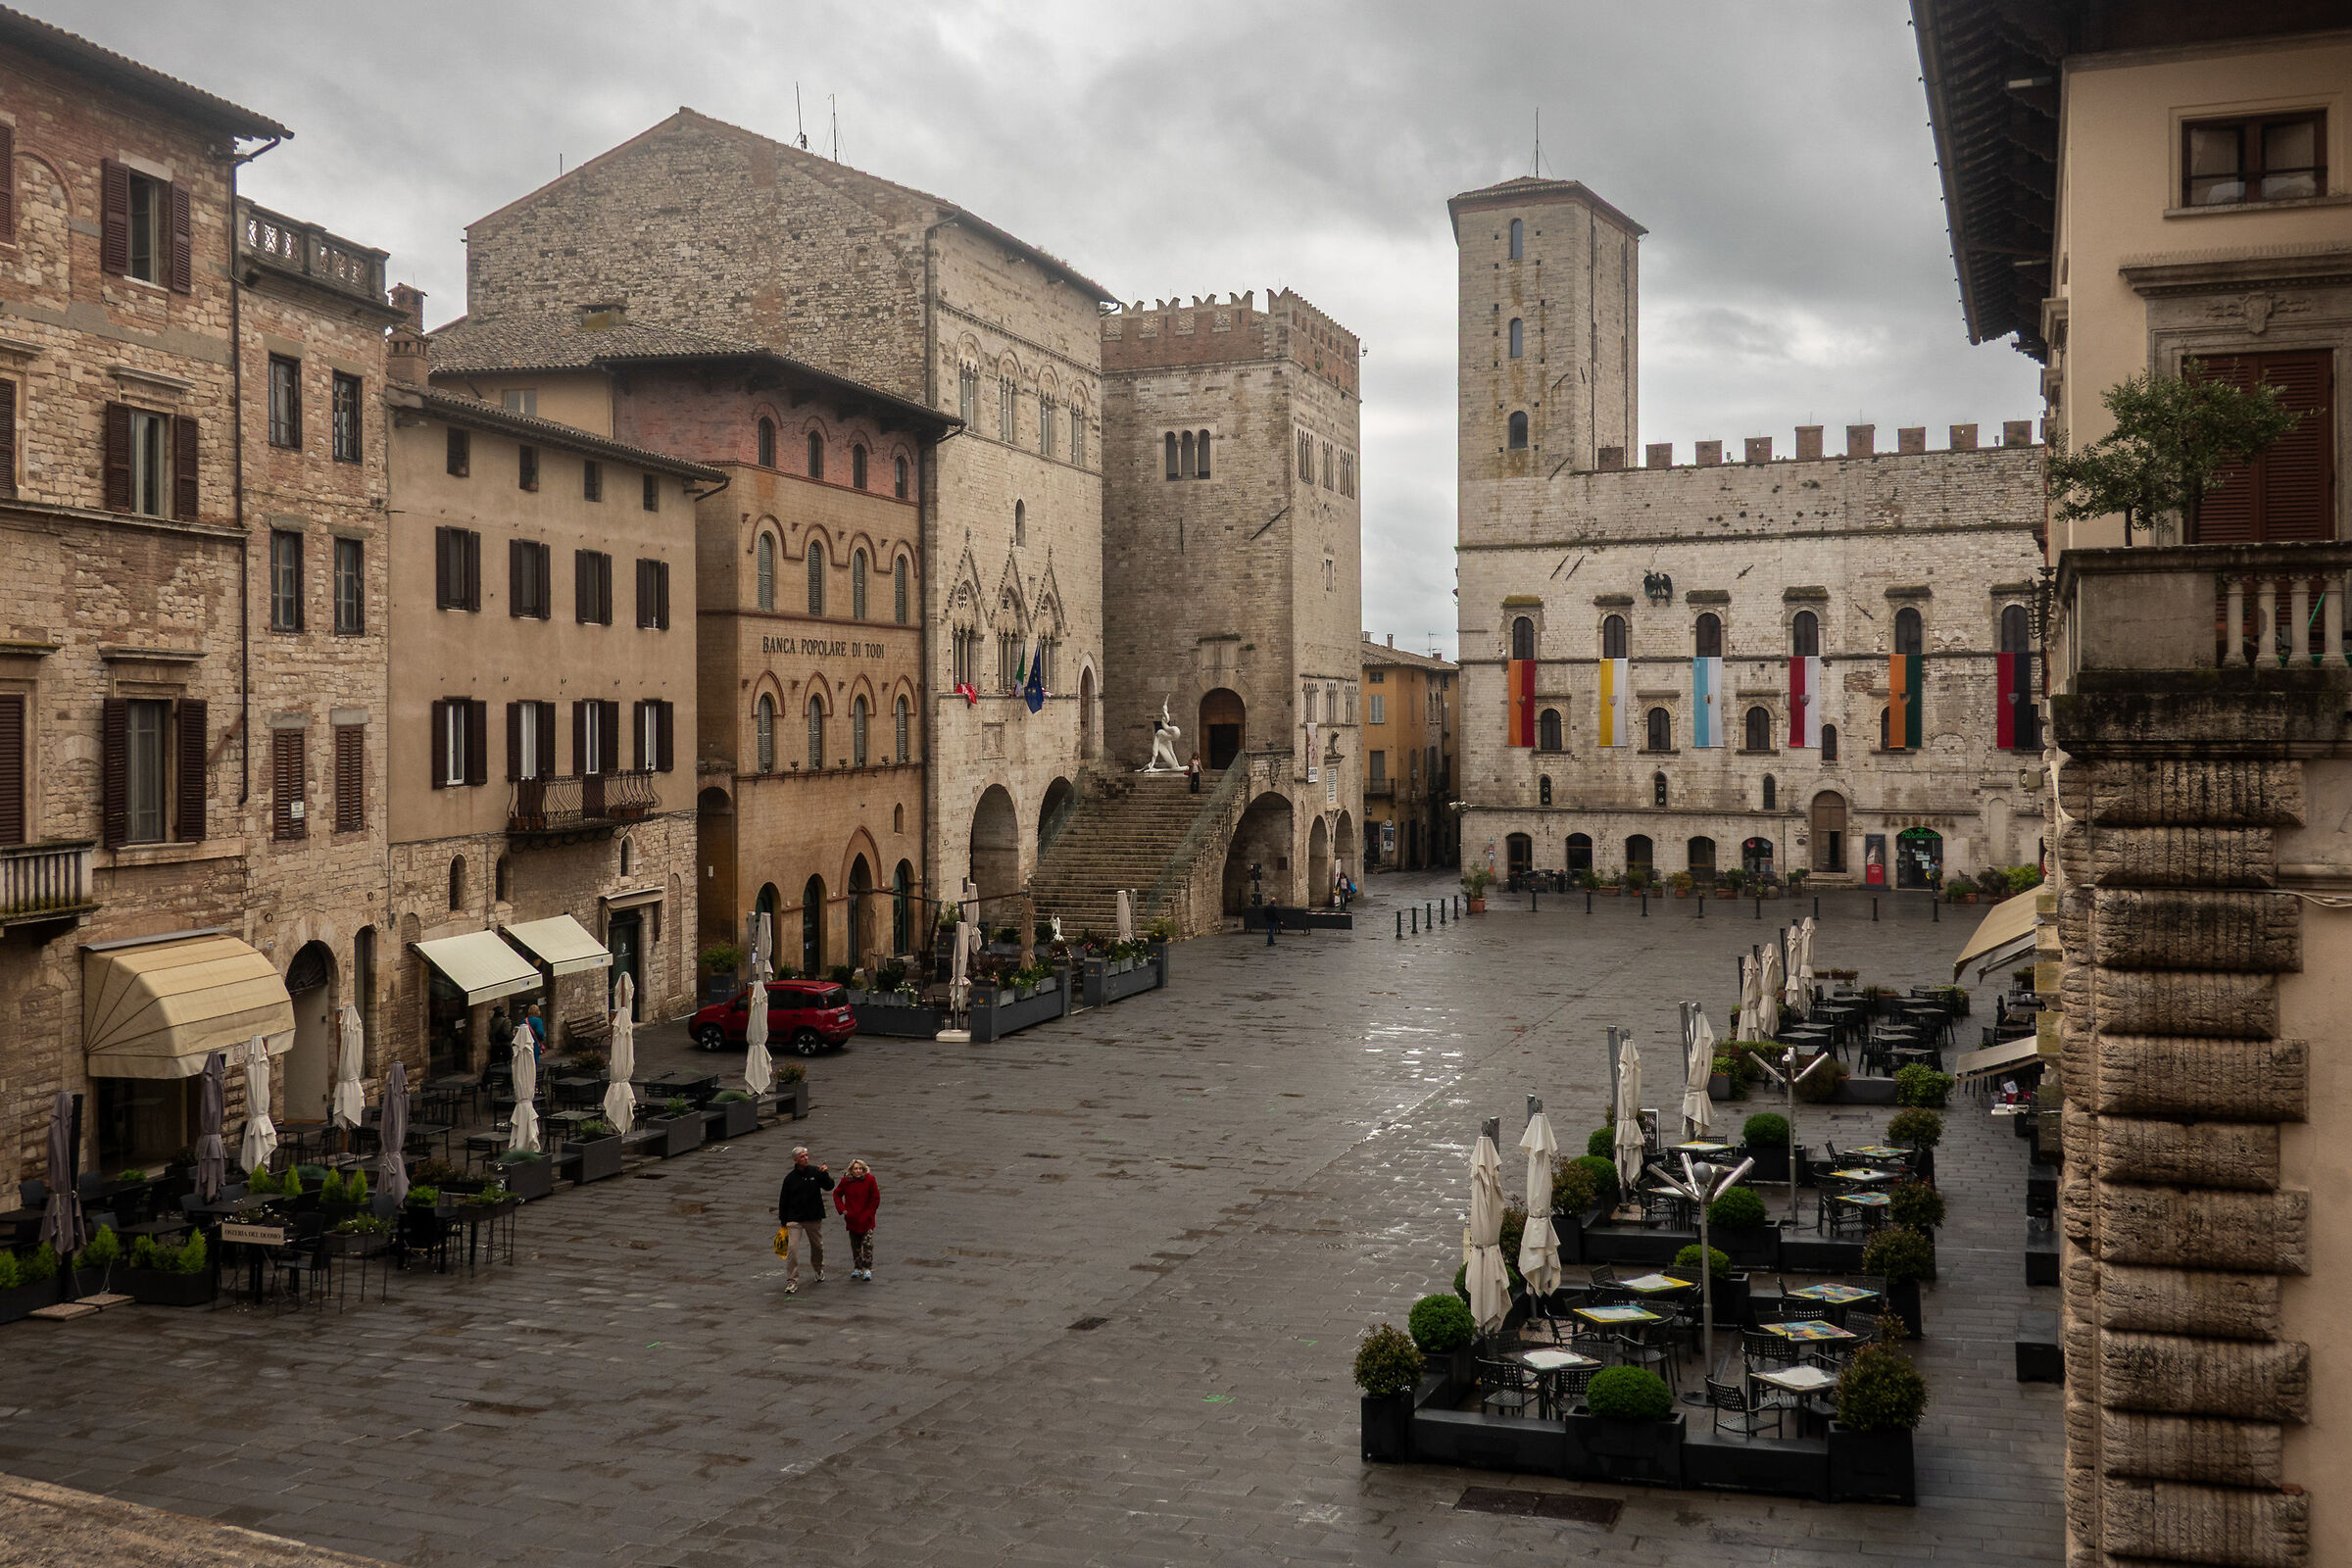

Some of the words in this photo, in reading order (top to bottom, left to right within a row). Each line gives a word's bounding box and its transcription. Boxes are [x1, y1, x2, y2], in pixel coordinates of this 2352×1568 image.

[762, 636, 796, 654] BANCA
[801, 638, 847, 657] POPOLARE
[852, 642, 861, 658] DI
[865, 643, 884, 659] TODI
[1883, 814, 1956, 828] FARMACIA
[224, 1229, 247, 1238] OSTERIA
